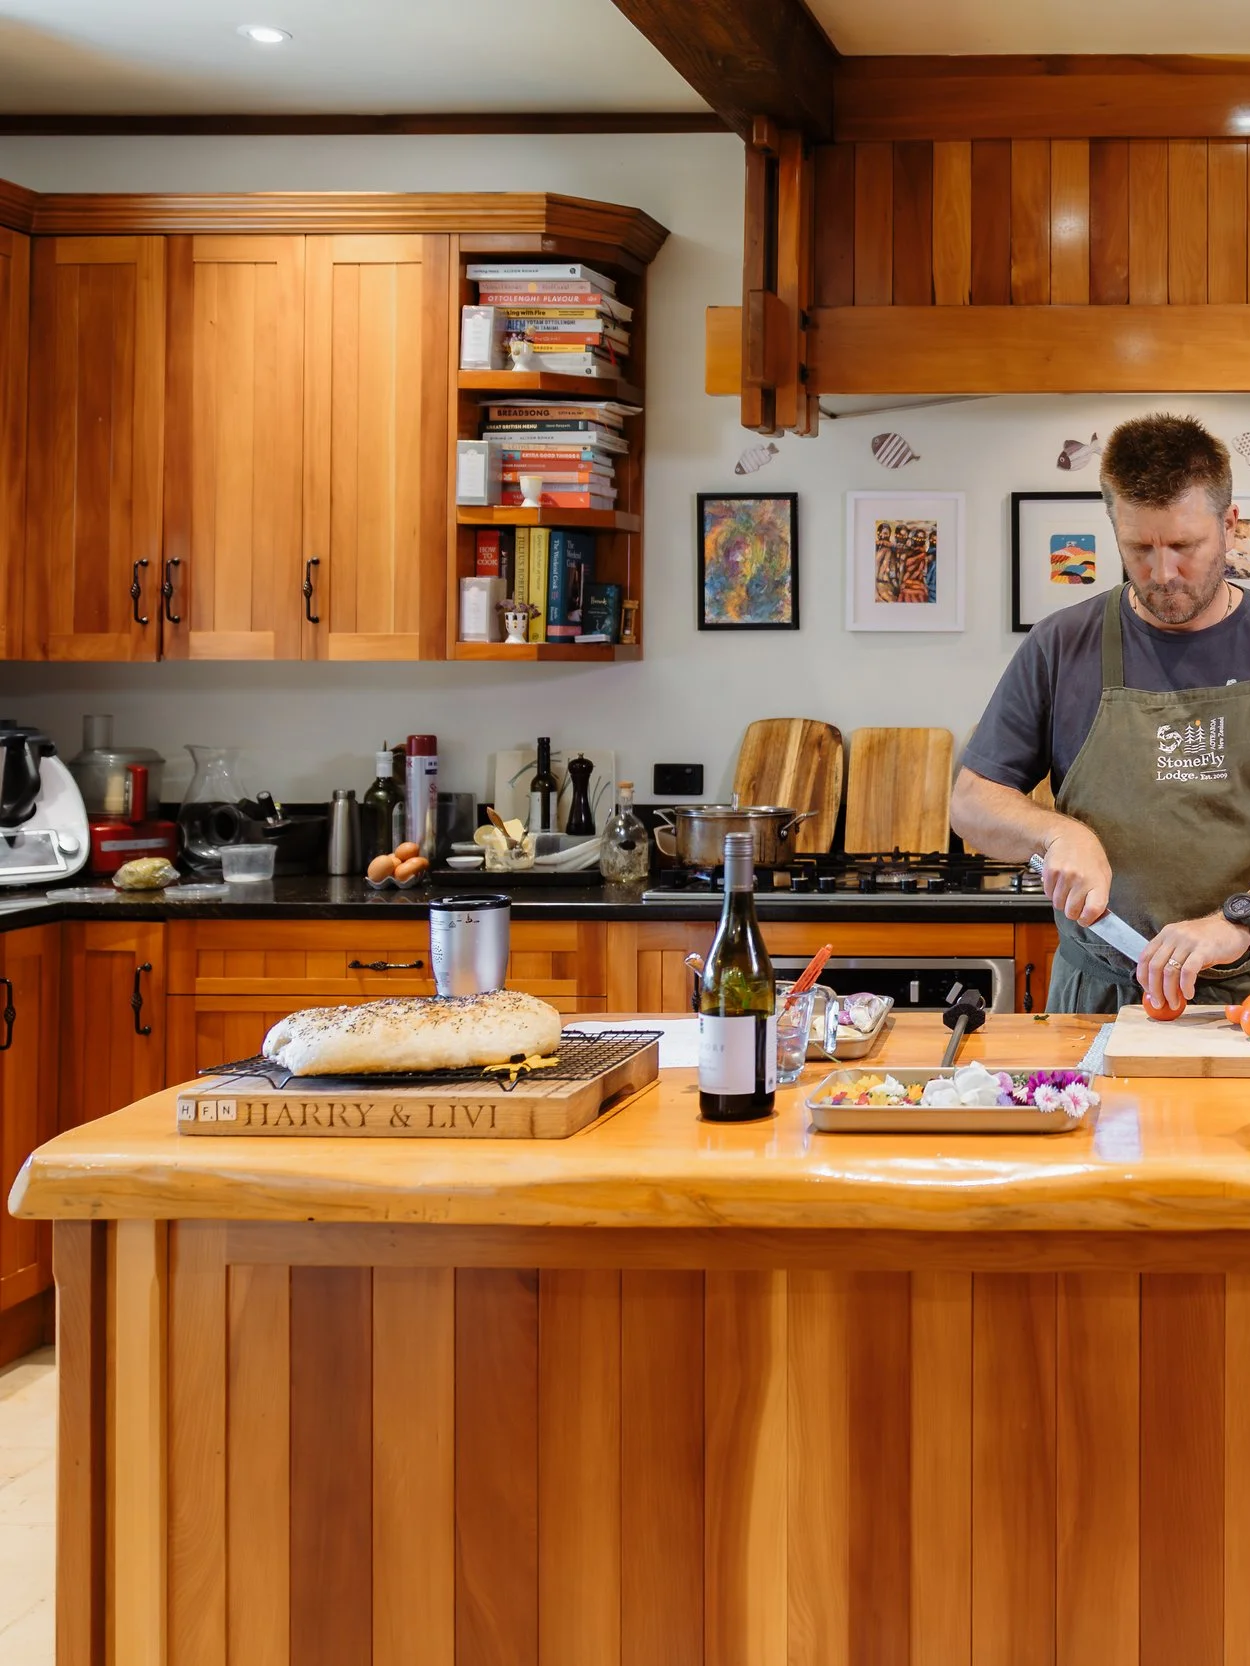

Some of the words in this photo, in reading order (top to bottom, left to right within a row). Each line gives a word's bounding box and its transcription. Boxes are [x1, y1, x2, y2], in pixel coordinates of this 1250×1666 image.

[543, 295, 580, 303] FLAVOUR
[497, 409, 550, 417] BREADSONG
[517, 536, 525, 566] JULIUS
[1209, 718, 1217, 750] AOTEAROA
[1217, 716, 1225, 737] Zealand
[1217, 737, 1225, 750] New
[1157, 752, 1225, 769] StoneFly
[1156, 770, 1198, 782] Lodge.
[1213, 772, 1228, 780] 2009
[244, 1103, 375, 1127] HARRY
[389, 1103, 411, 1128] &
[427, 1104, 498, 1129] LIVI
